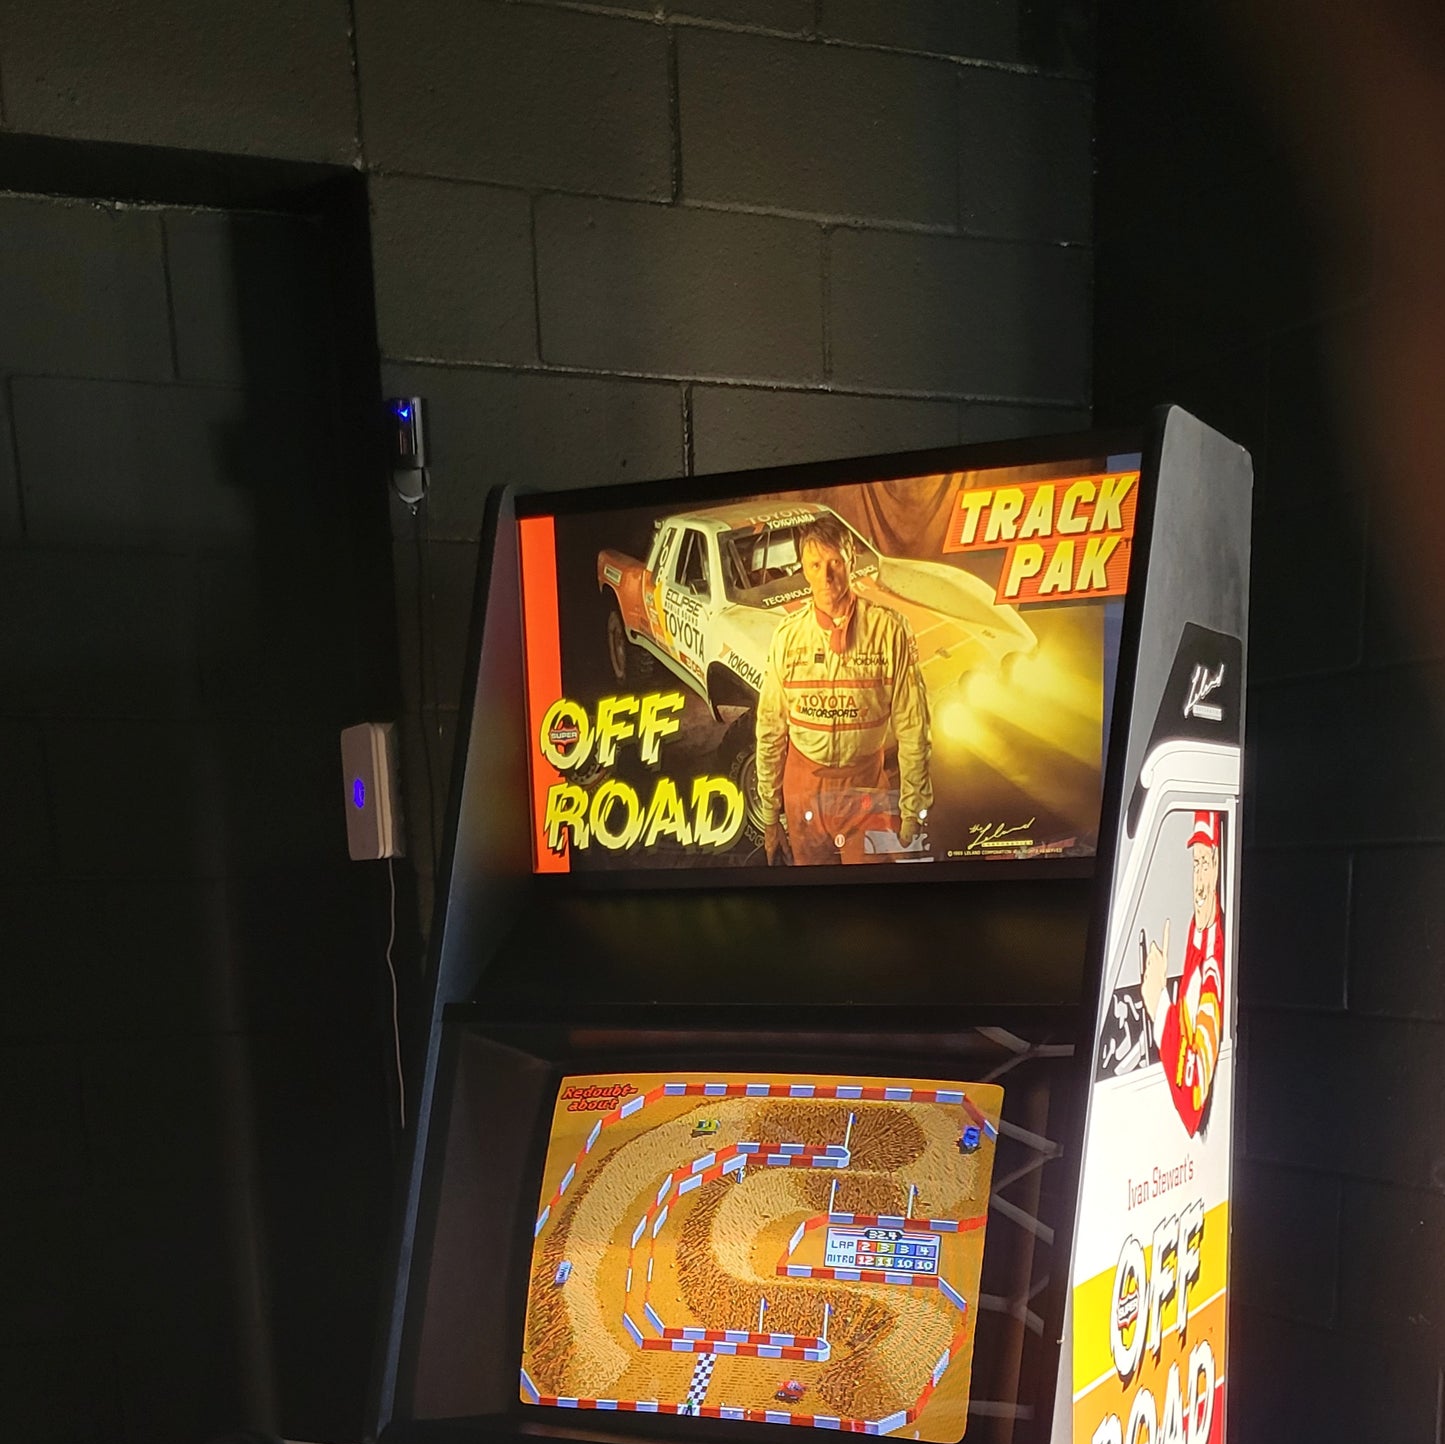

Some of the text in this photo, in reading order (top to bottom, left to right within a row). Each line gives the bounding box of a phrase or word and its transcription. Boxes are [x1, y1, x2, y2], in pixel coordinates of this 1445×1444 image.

[960, 475, 1137, 545] TRACK
[766, 513, 816, 530] YOKOHAMA
[1004, 535, 1122, 597] PAK
[665, 587, 703, 617] ECLIPSE
[762, 586, 812, 607] TECHNOLO
[663, 608, 706, 663] TOYOTA
[727, 650, 764, 690] YOKOHA
[801, 694, 857, 709] TOYOTA
[801, 707, 860, 719] MOTORSPORTS
[540, 693, 685, 770] OFF
[551, 731, 577, 739] SUPER
[544, 775, 745, 850] ROAD
[561, 1083, 638, 1100] Redoubt-
[567, 1098, 619, 1111] about
[1127, 1154, 1194, 1212] Ivan Stewart's
[868, 1230, 898, 1240] 32.4
[831, 1240, 930, 1256] LAP 2 3 3 4
[826, 1254, 854, 1264] NITRO
[858, 1256, 875, 1265] 12
[896, 1259, 914, 1269] 10
[916, 1261, 934, 1271] 10
[1110, 1198, 1205, 1390] OFF
